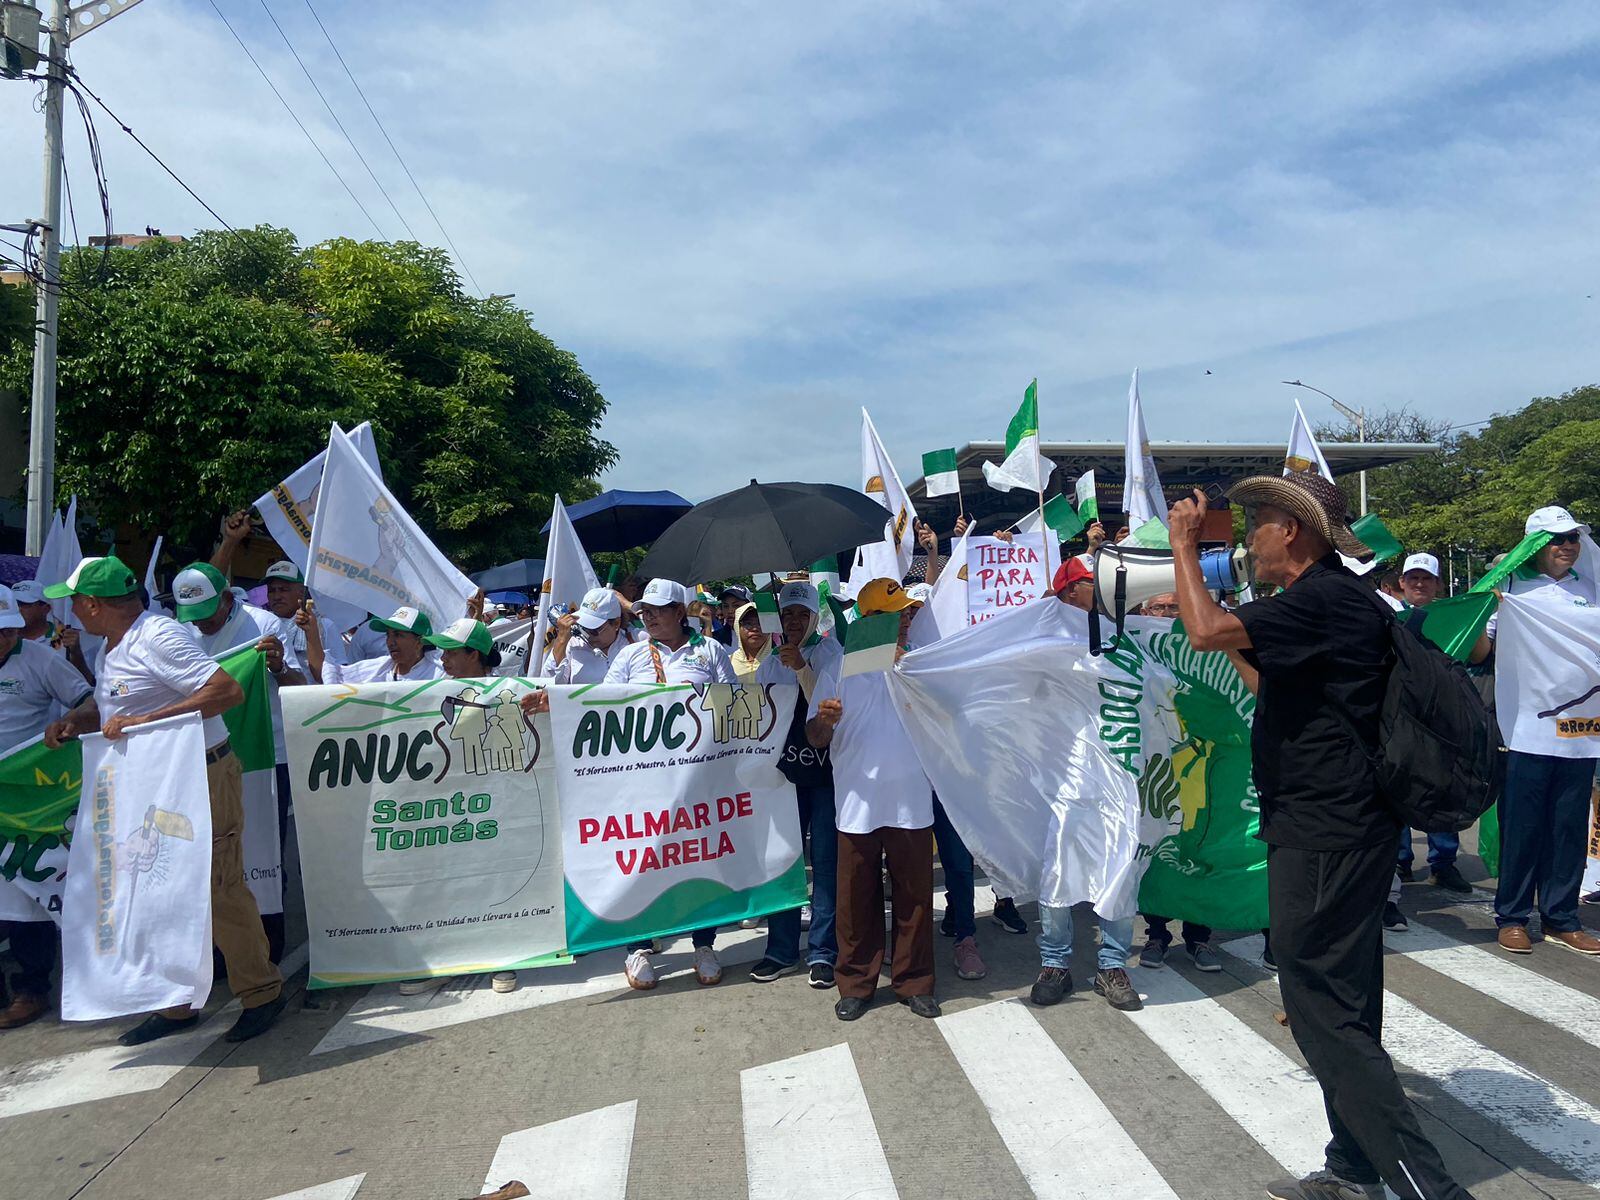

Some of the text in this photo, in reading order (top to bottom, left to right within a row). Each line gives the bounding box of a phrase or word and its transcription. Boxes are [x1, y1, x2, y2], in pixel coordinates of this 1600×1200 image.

[975, 544, 1038, 566] TIERRA
[976, 568, 1035, 590] PARA
[995, 590, 1027, 607] LAS
[491, 641, 528, 657] AMPE
[572, 701, 686, 758] ANUC
[308, 729, 433, 791] ANUC
[586, 765, 624, 775] Horizonte
[634, 760, 667, 770] Nuestro,
[668, 757, 676, 766] la
[678, 753, 707, 765] Unidad
[745, 745, 753, 754] la
[372, 792, 491, 824] Santo
[578, 792, 753, 844] PALMAR DE
[371, 818, 498, 851] Tomás
[615, 830, 735, 875] VARELA
[338, 927, 378, 937] Horizonte
[389, 923, 423, 934] Nuestro,
[425, 920, 434, 929] la
[436, 915, 467, 928] Unidad
[482, 912, 512, 922] Llevara
[521, 908, 529, 918] la
